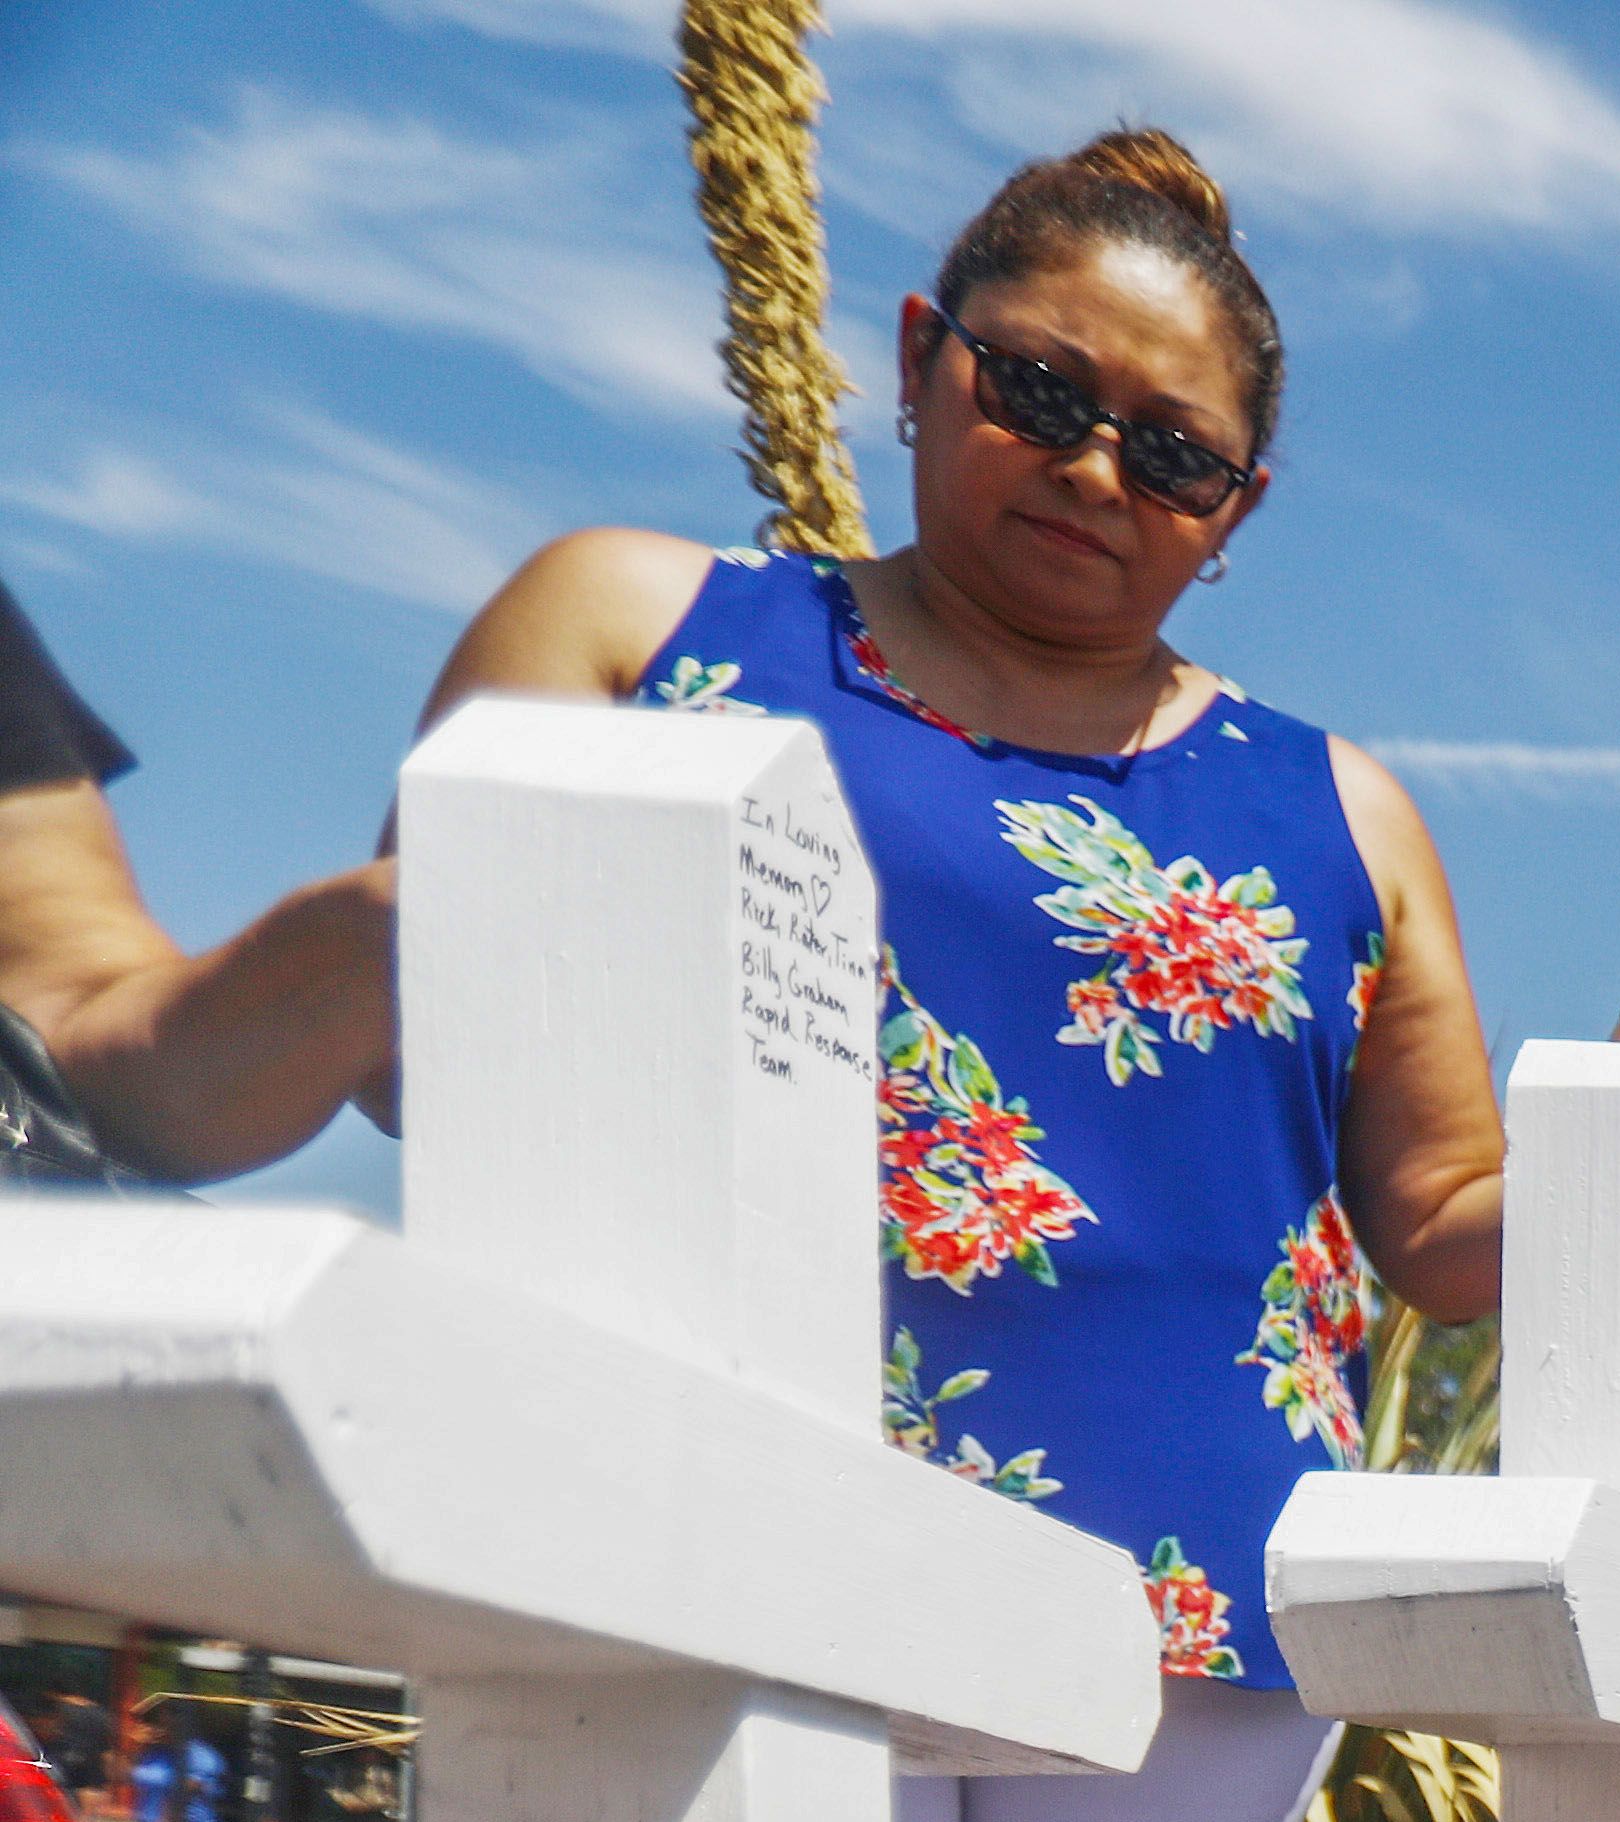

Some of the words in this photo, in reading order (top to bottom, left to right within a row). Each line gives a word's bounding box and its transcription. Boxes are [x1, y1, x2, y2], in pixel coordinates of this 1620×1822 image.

[740, 842, 808, 913] Memory
[741, 796, 775, 836] In
[784, 800, 841, 876] Loving
[741, 940, 783, 1000] Billy
[788, 958, 850, 1027] Graham
[742, 985, 799, 1042] Rapid
[804, 1009, 873, 1083] Response
